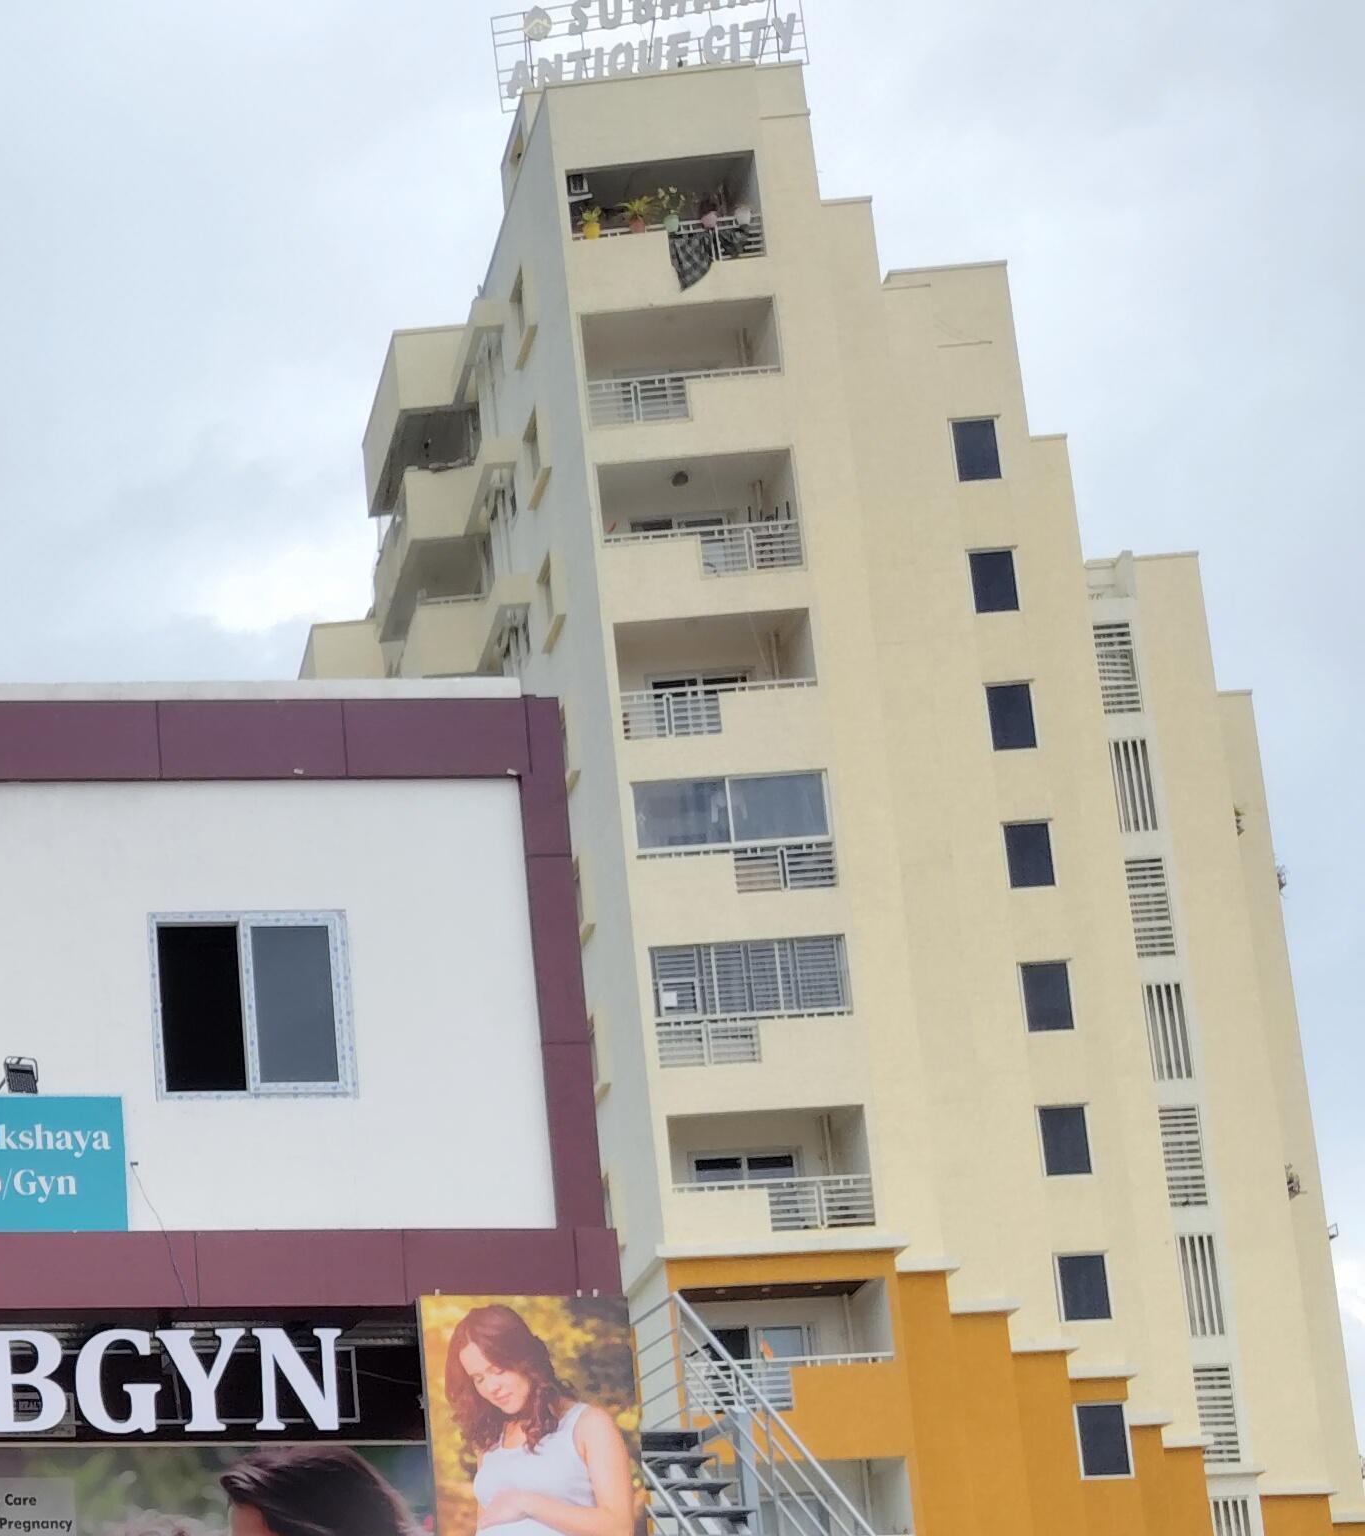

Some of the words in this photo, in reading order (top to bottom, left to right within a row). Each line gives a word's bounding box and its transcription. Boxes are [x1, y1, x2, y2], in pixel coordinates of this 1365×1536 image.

[507, 31, 691, 98] ANTIQUE
[703, 13, 796, 64] CITY
[4, 1494, 37, 1506] Care
[0, 1517, 72, 1532] Pregnancy
